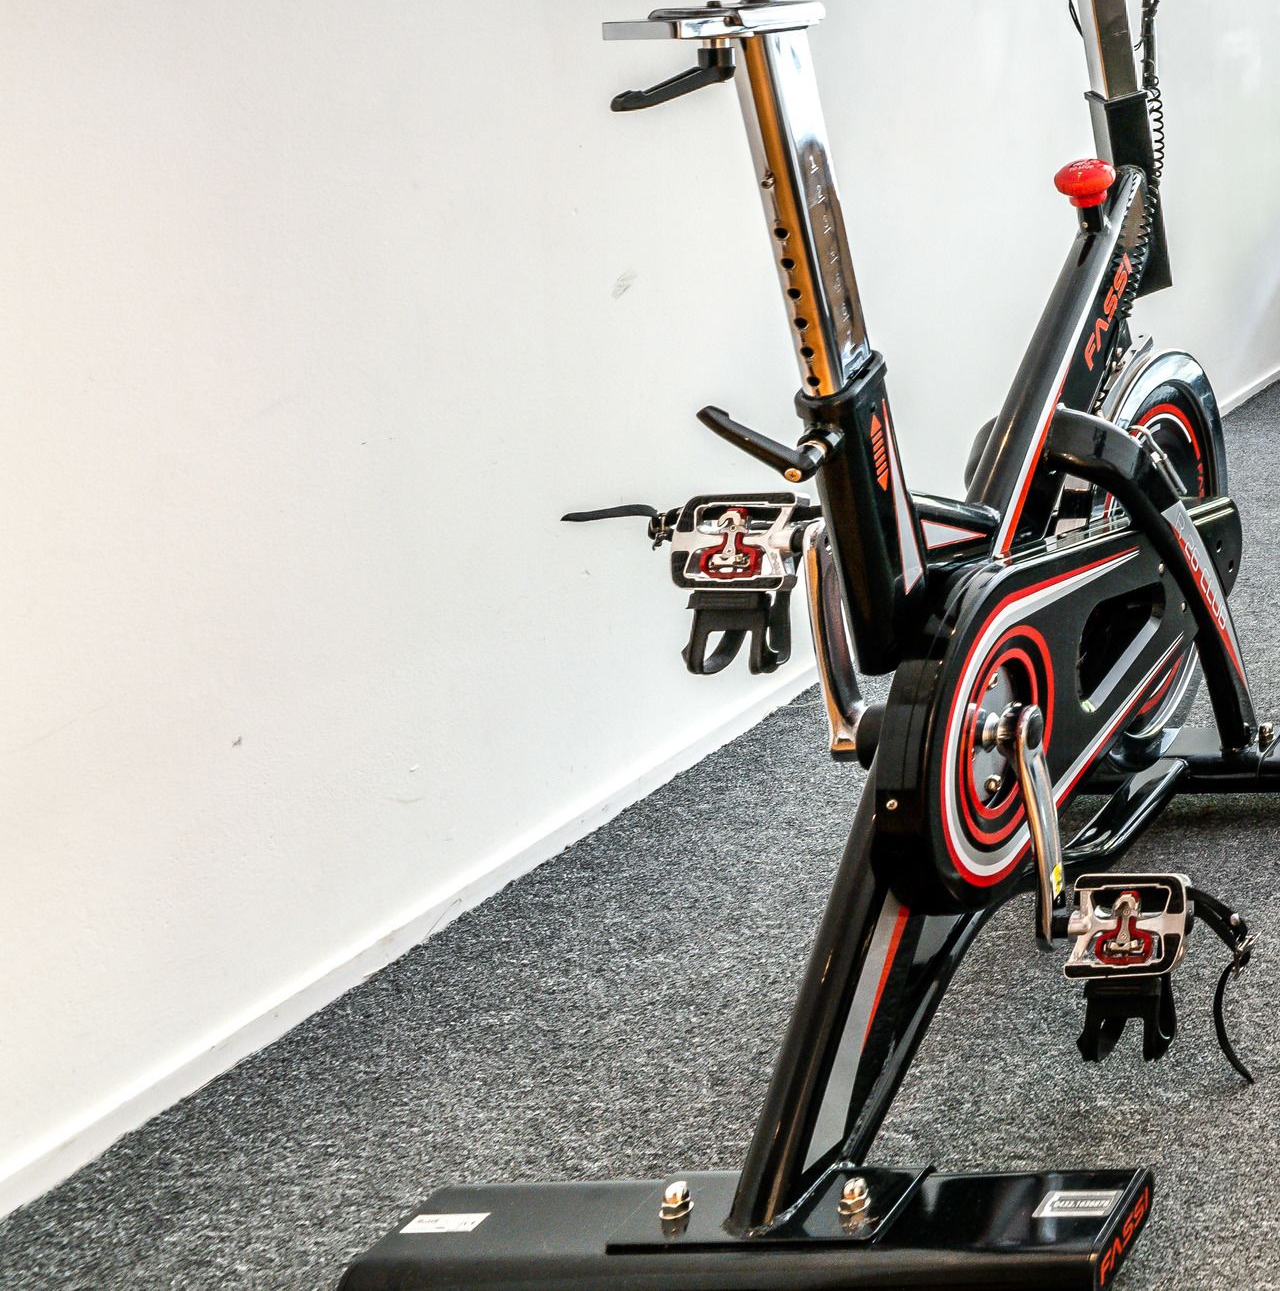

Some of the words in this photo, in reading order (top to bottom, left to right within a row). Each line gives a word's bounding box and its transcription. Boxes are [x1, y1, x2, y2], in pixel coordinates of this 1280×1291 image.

[1084, 252, 1132, 371] FASSI
[1184, 537, 1201, 573] 26
[1200, 567, 1228, 631] CLUB
[1101, 1187, 1149, 1285] FASSI
